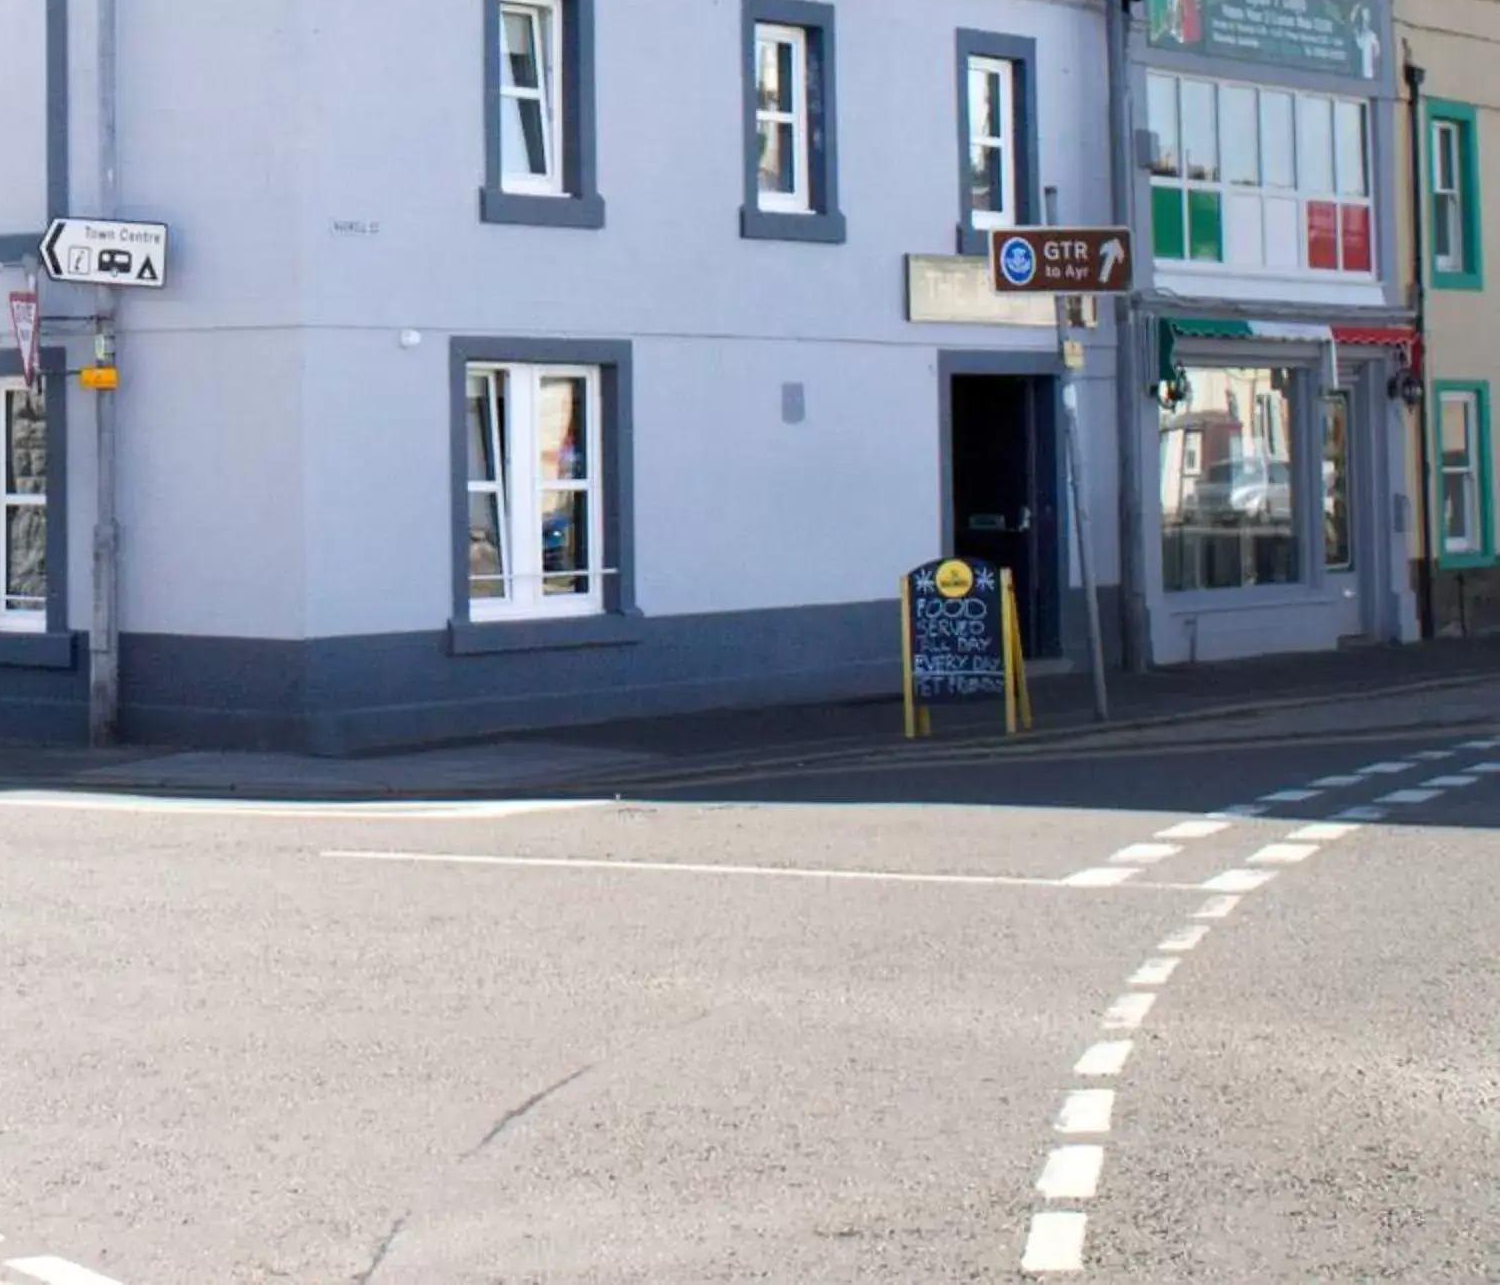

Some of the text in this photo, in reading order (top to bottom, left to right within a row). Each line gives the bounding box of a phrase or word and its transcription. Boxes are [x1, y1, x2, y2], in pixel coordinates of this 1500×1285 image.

[85, 225, 161, 244] Town Centre
[1043, 241, 1088, 261] GTR
[1046, 265, 1088, 282] to Ayr
[916, 597, 988, 619] FOOD
[958, 636, 993, 653] DAY
